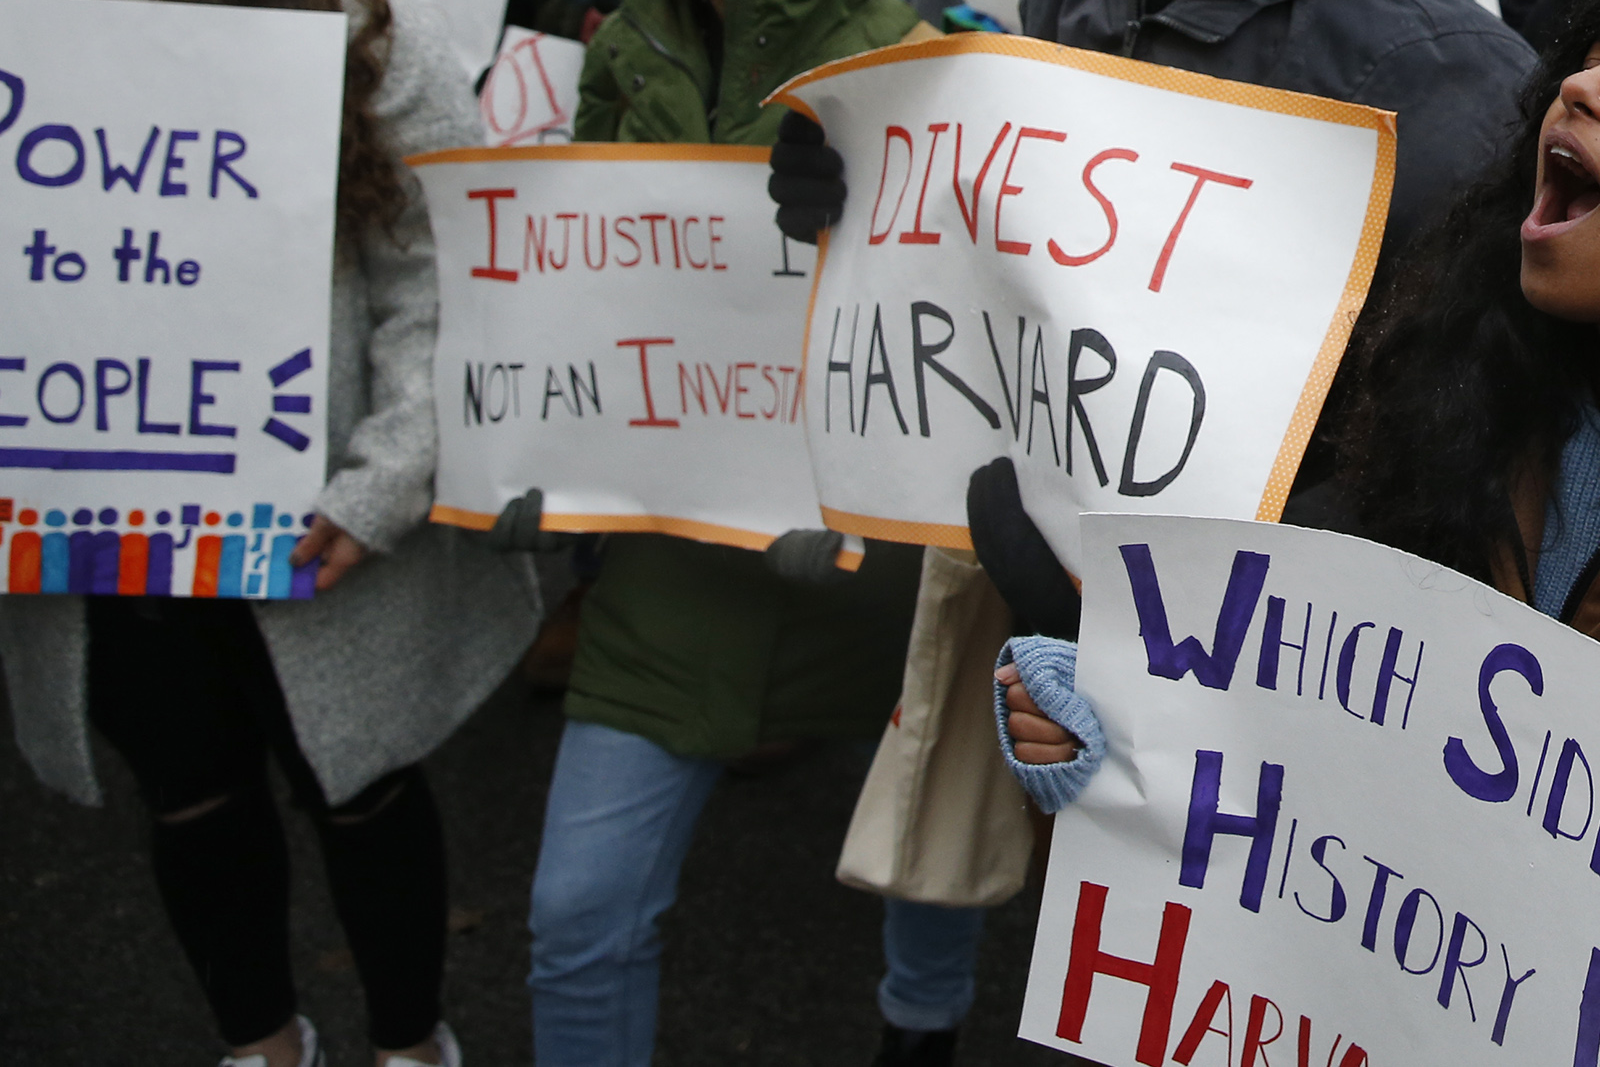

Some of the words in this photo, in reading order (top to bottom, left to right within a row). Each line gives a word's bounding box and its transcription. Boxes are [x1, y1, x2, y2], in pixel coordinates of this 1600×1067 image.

[24, 230, 86, 281] to
[114, 228, 200, 286] the
[467, 188, 728, 282] INJUSTICE
[868, 121, 1254, 292] DIVEST
[464, 360, 525, 427] NOT
[541, 359, 602, 420] AN
[825, 300, 1206, 496] HARVARD
[1118, 543, 1424, 730] WHICH
[1178, 749, 1537, 1047] HISTORY
